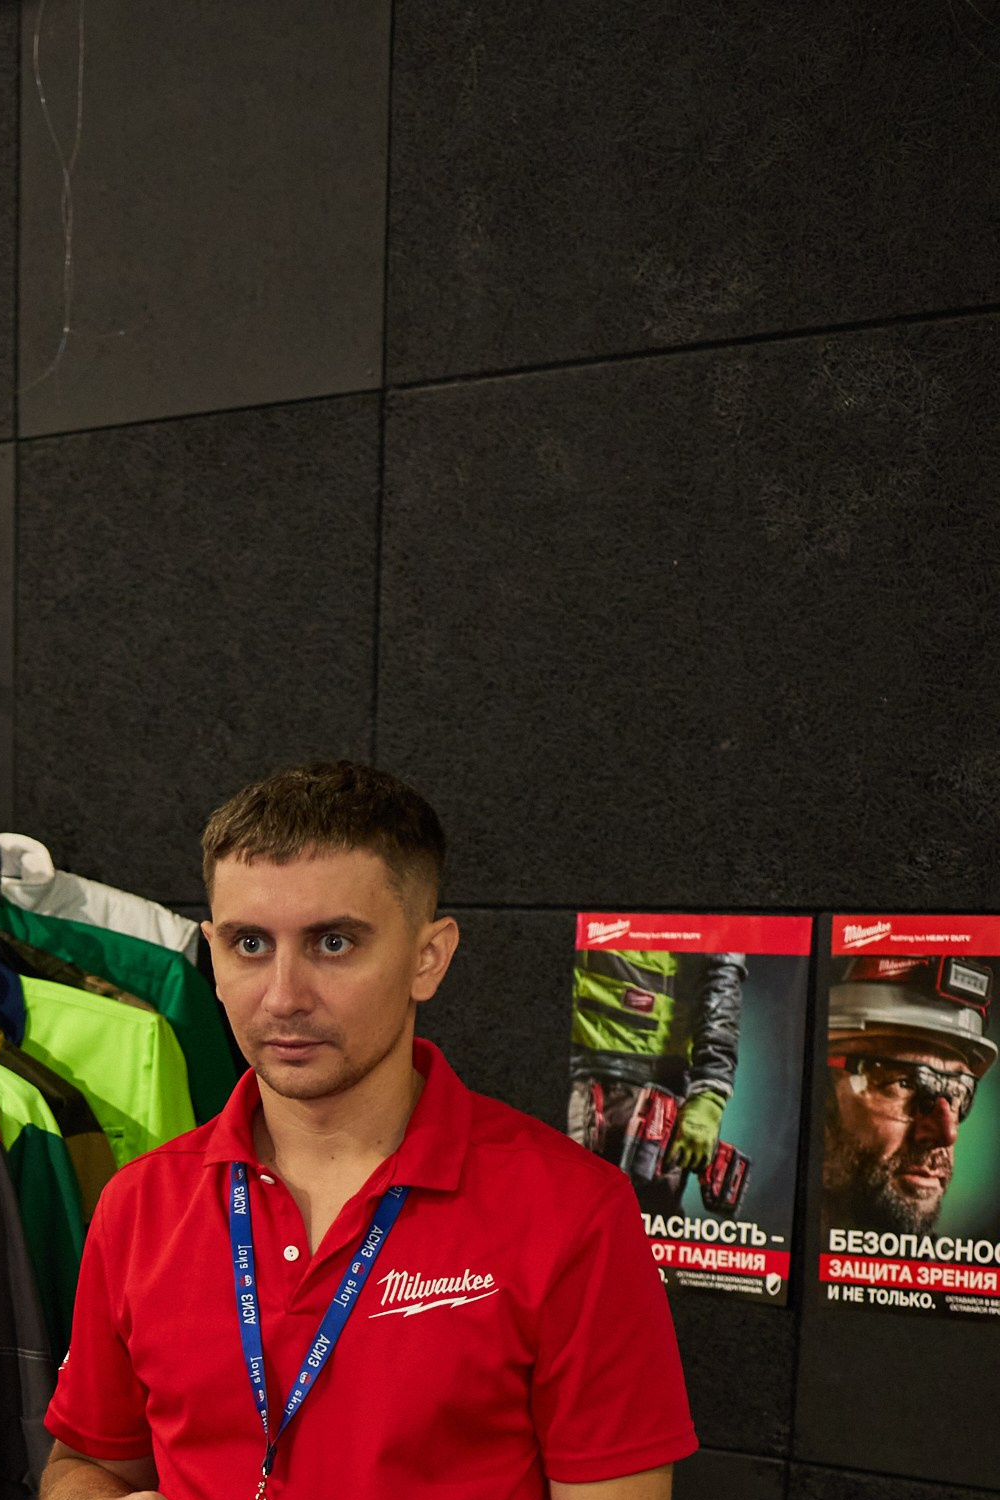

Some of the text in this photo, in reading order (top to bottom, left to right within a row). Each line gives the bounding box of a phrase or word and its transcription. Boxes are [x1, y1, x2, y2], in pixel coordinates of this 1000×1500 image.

[234, 1186, 247, 1215] АСИЗ
[361, 1225, 383, 1258] АСИЗ
[641, 1213, 767, 1246] ПАСНОСТЬ
[652, 1243, 766, 1271] ОТ ПАДЕНИЯ
[377, 1269, 495, 1306] Milwaukee
[828, 1259, 997, 1291] ЗАЩИТА ЗРЕНИЯ
[241, 1293, 256, 1324] АСИЗ
[827, 1284, 936, 1309] И НЕ ТОЛЬКО.
[307, 1333, 331, 1368] АСИЗ
